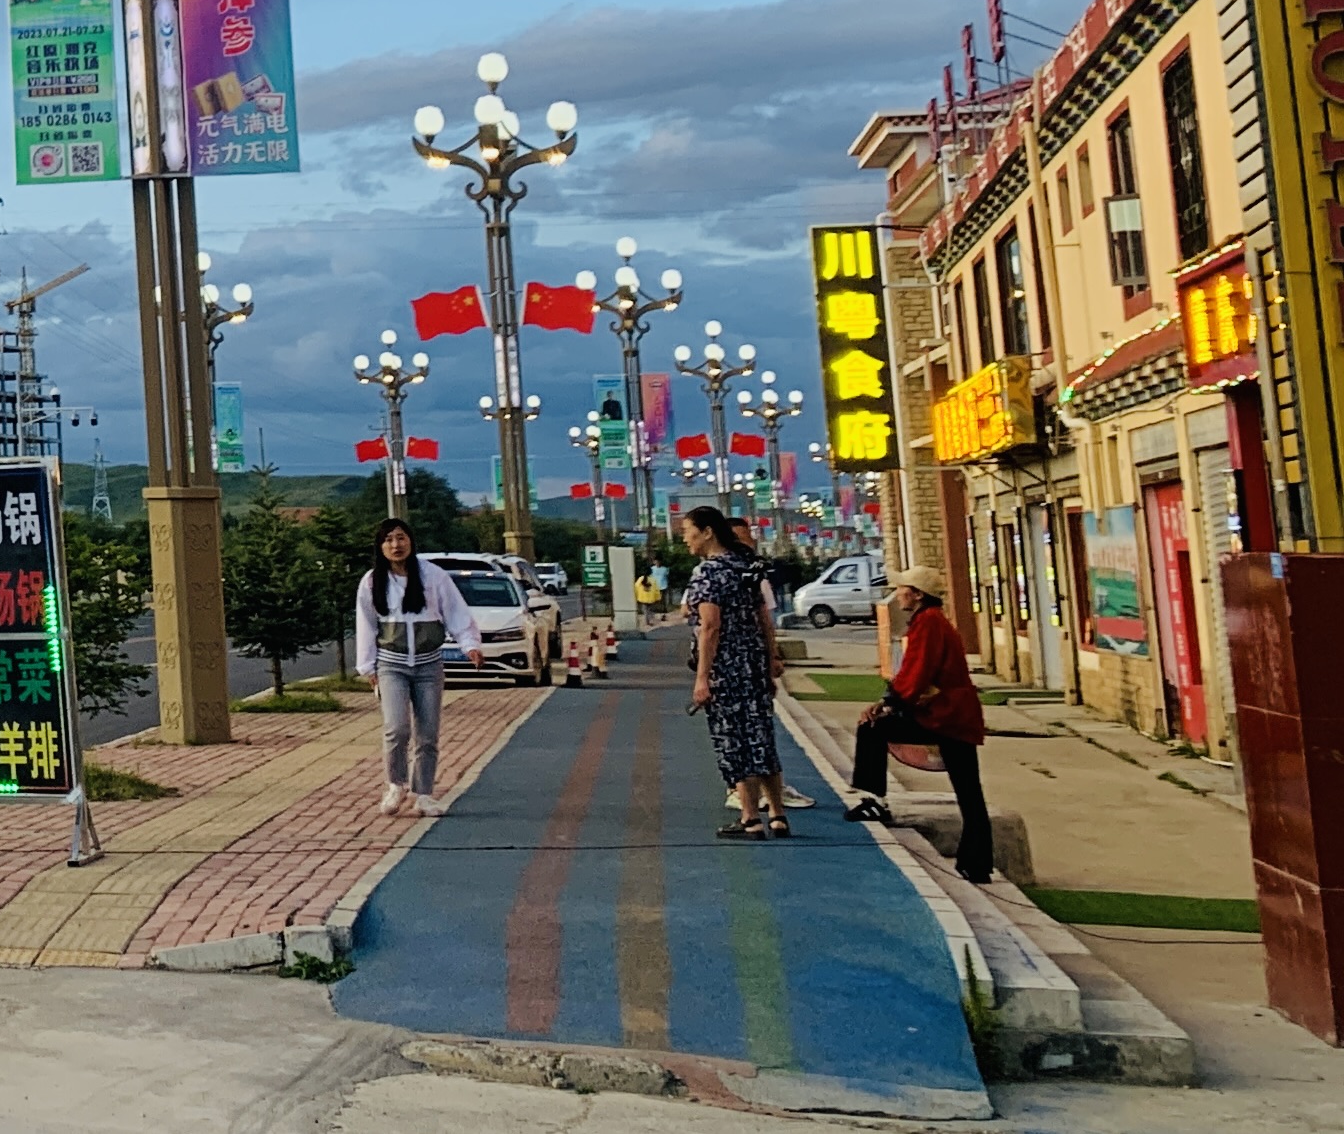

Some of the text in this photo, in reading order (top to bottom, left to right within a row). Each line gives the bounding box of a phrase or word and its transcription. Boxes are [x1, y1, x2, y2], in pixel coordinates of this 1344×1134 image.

[17, 25, 105, 40] 2023.07.21-07.23
[21, 111, 112, 128] 185 0286 0143
[196, 113, 290, 138] 元气满电
[197, 140, 290, 165] 活力无限
[822, 230, 892, 460] 川粤食府
